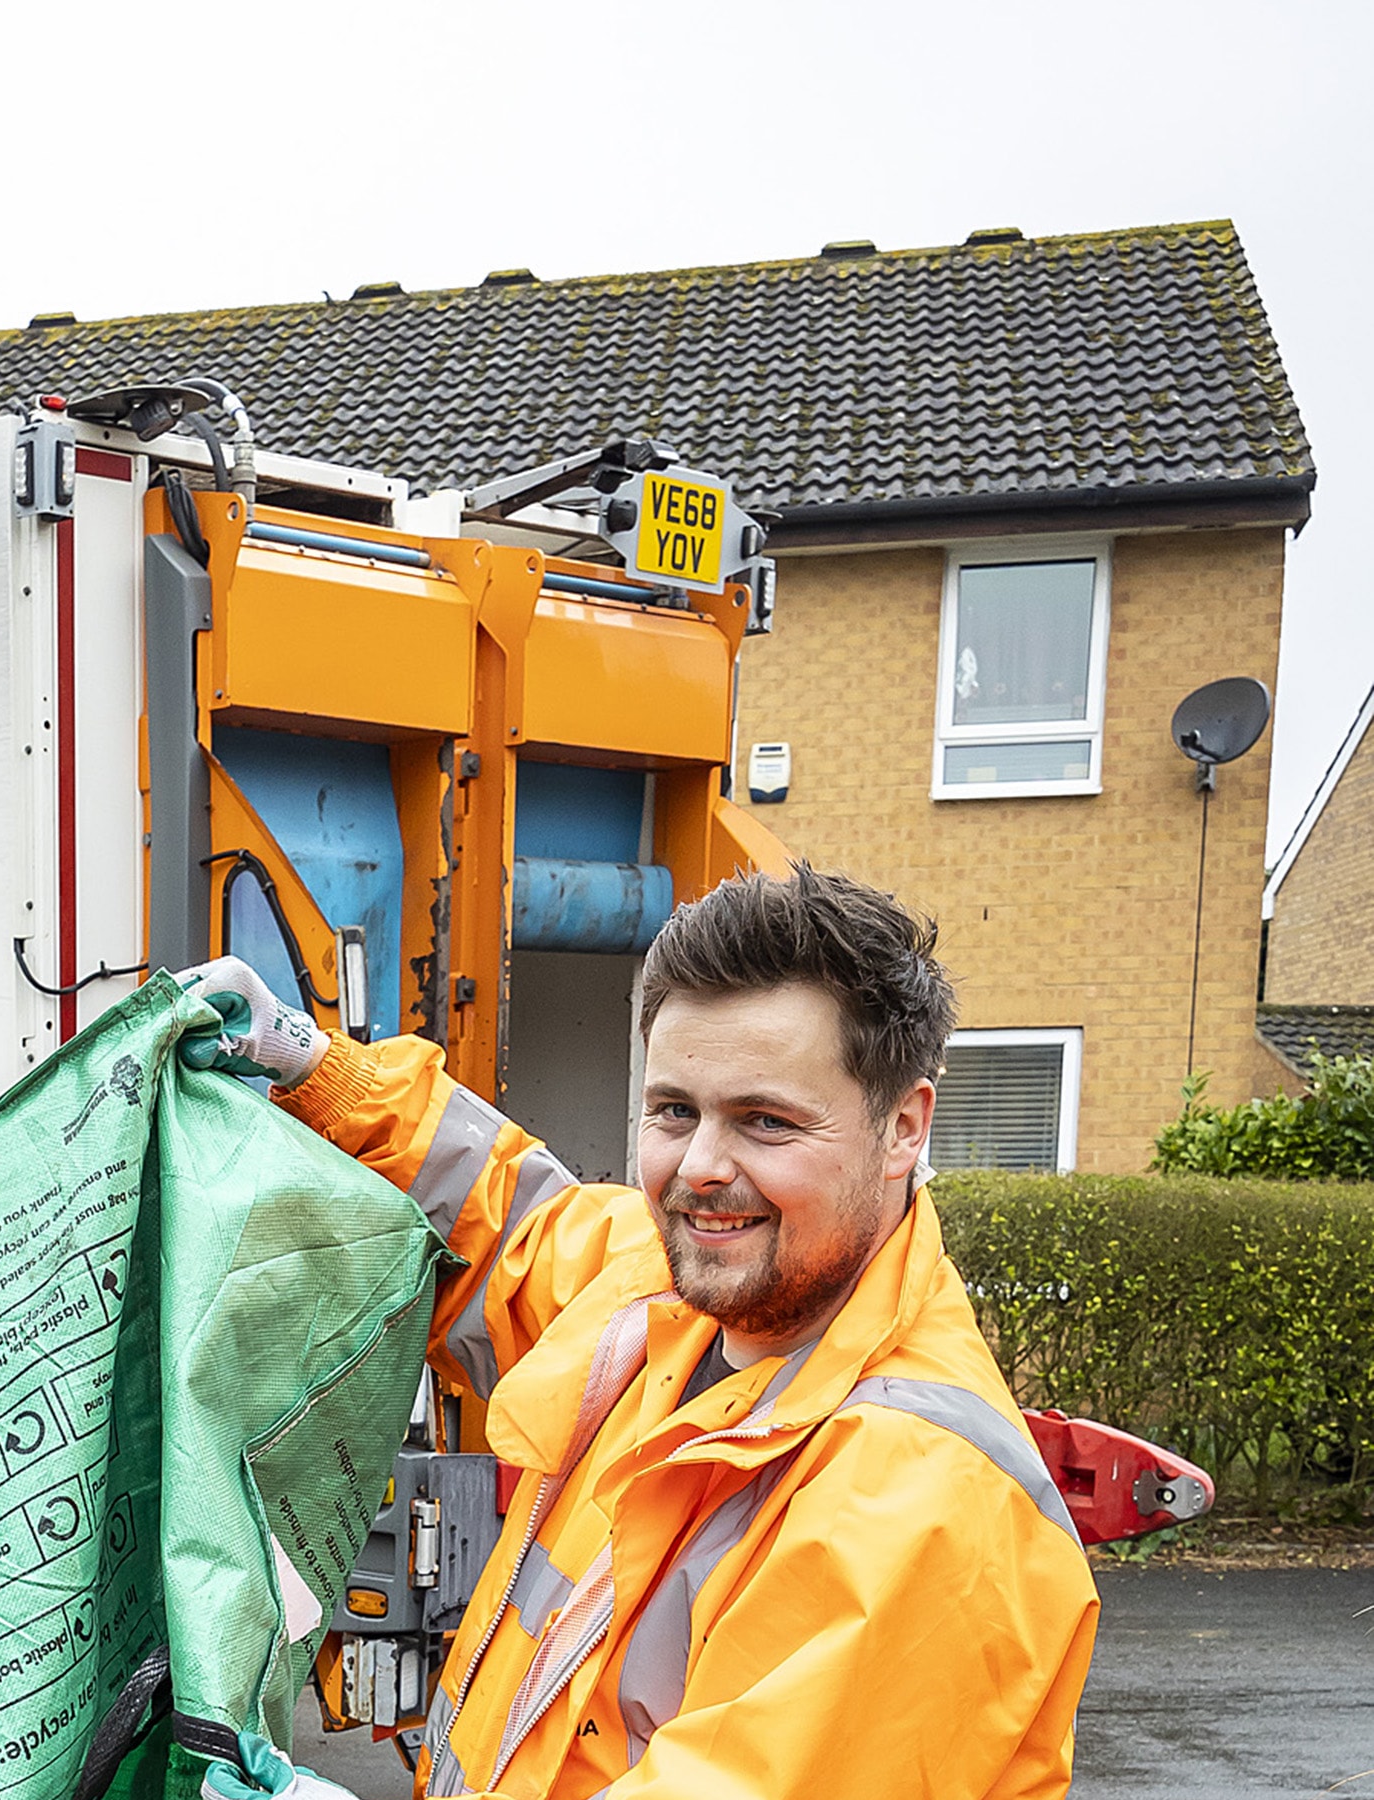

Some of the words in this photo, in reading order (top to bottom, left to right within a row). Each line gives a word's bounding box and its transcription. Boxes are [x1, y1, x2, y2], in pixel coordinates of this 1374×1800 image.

[652, 481, 716, 530] VE68
[656, 529, 704, 573] YOV
[105, 1160, 127, 1179] and
[29, 1183, 62, 1212] Thank
[68, 1171, 102, 1205] ensure
[107, 1192, 128, 1209] bag
[3, 1205, 28, 1225] you
[75, 1201, 106, 1225] must
[30, 1219, 51, 1239] can
[0, 1258, 37, 1289] sealed
[40, 1294, 90, 1332] plastic
[92, 1371, 113, 1388] rays
[83, 1396, 105, 1418] and
[353, 1489, 363, 1508] for
[279, 1495, 302, 1536] inside
[304, 1550, 317, 1566] to
[325, 1531, 347, 1573] centre.
[313, 1564, 335, 1600] down
[23, 1628, 69, 1666] plastic
[78, 1677, 97, 1709] an
